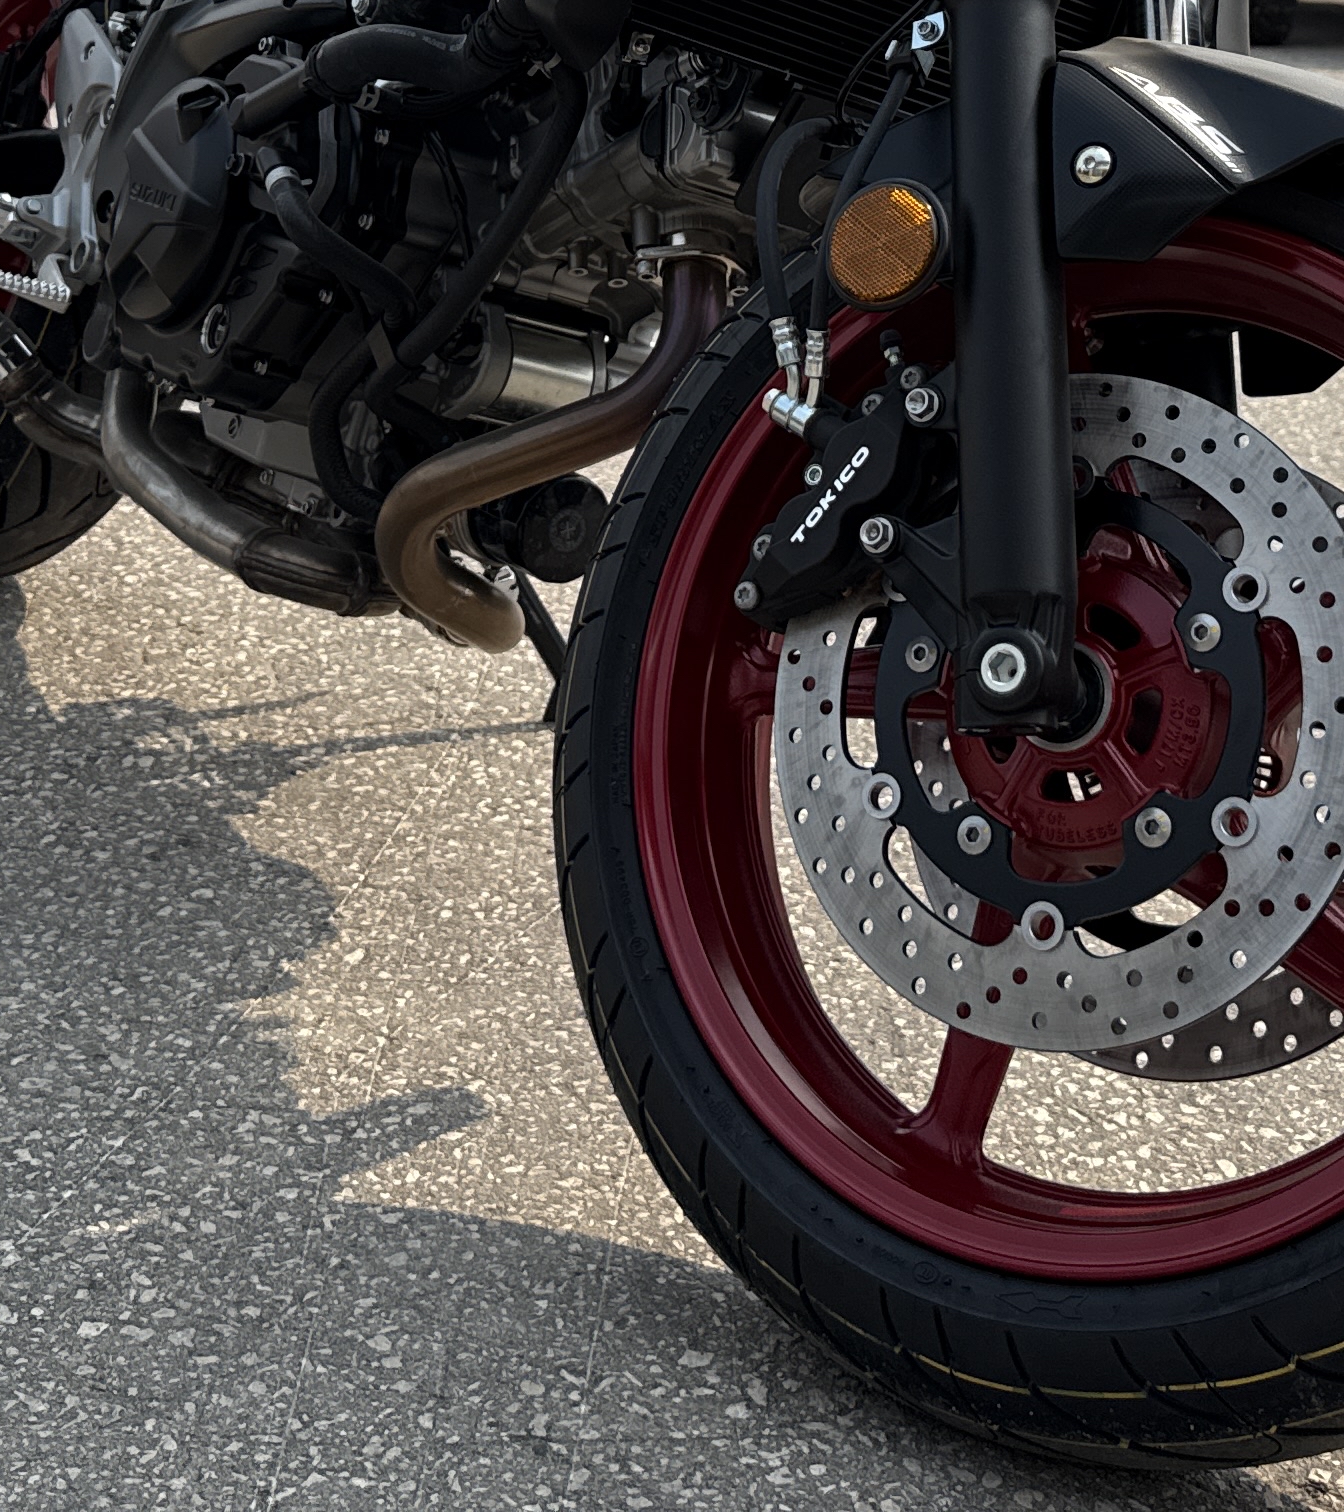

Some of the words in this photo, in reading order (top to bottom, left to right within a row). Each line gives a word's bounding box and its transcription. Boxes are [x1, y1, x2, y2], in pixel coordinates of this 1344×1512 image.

[1107, 65, 1246, 157] ABS
[129, 182, 177, 213] SUZUKI
[789, 445, 870, 543] TOKICO
